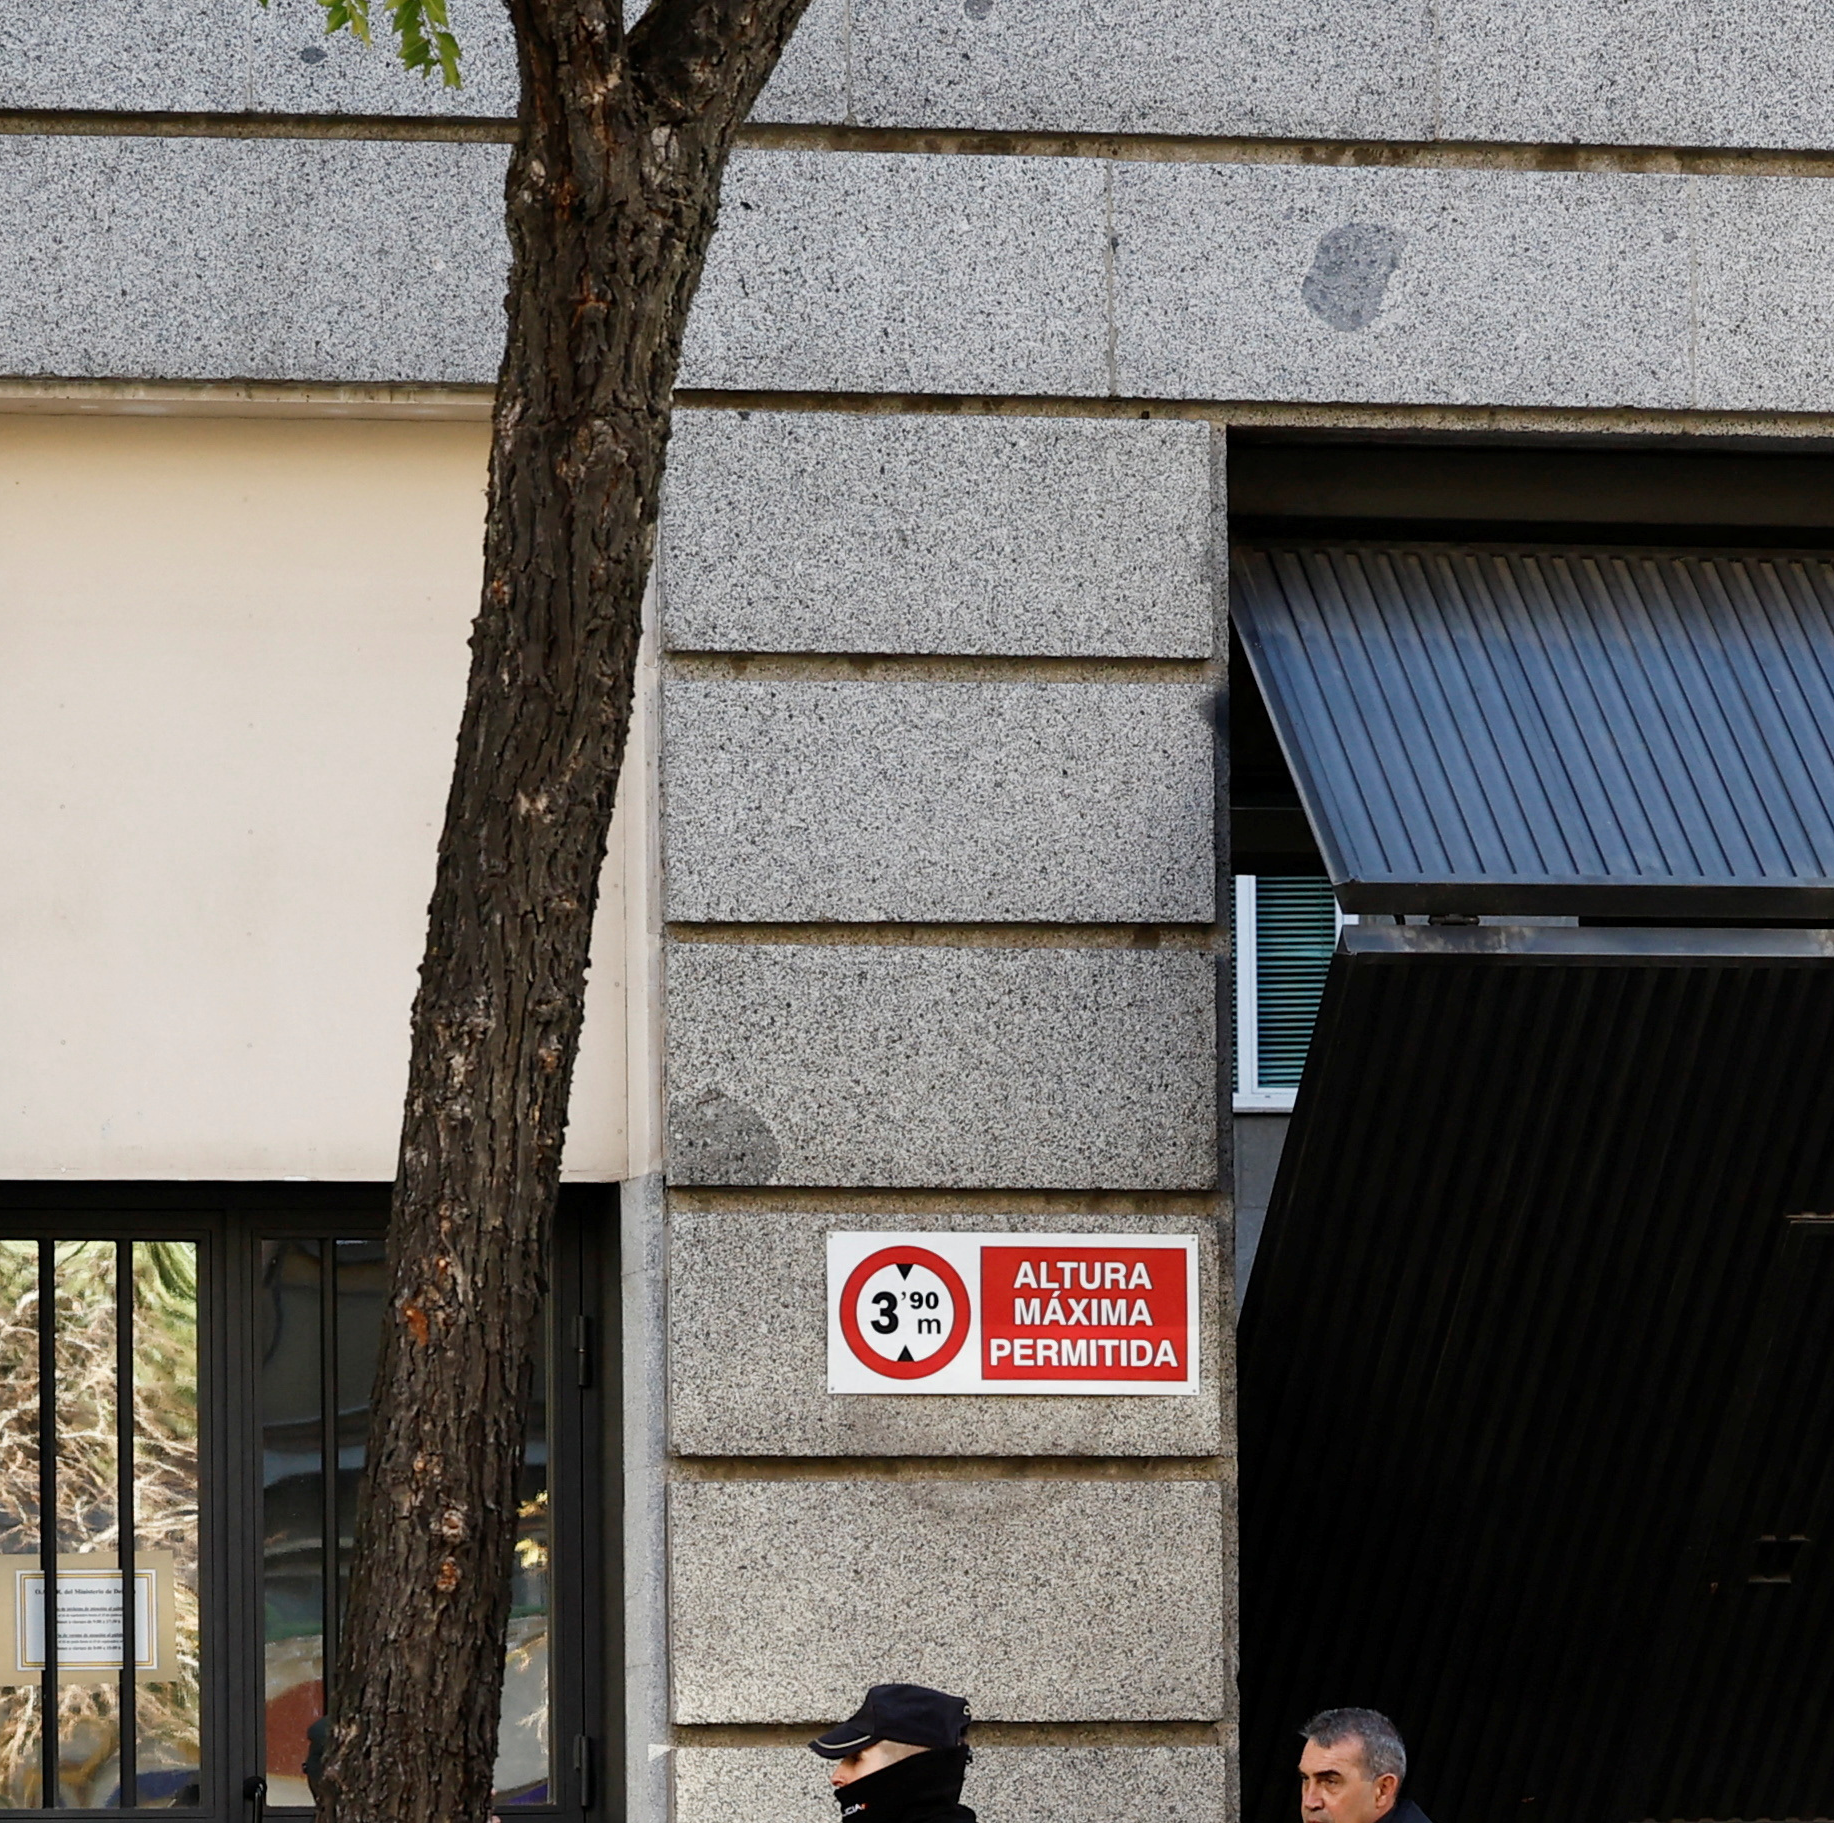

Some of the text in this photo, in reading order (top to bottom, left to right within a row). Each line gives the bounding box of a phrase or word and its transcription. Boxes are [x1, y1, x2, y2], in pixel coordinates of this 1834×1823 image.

[1013, 1261, 1153, 1290] ALTURA
[1014, 1290, 1153, 1327] MÁXIMA
[917, 1316, 942, 1335] m
[989, 1338, 1179, 1368] PERMITIDA
